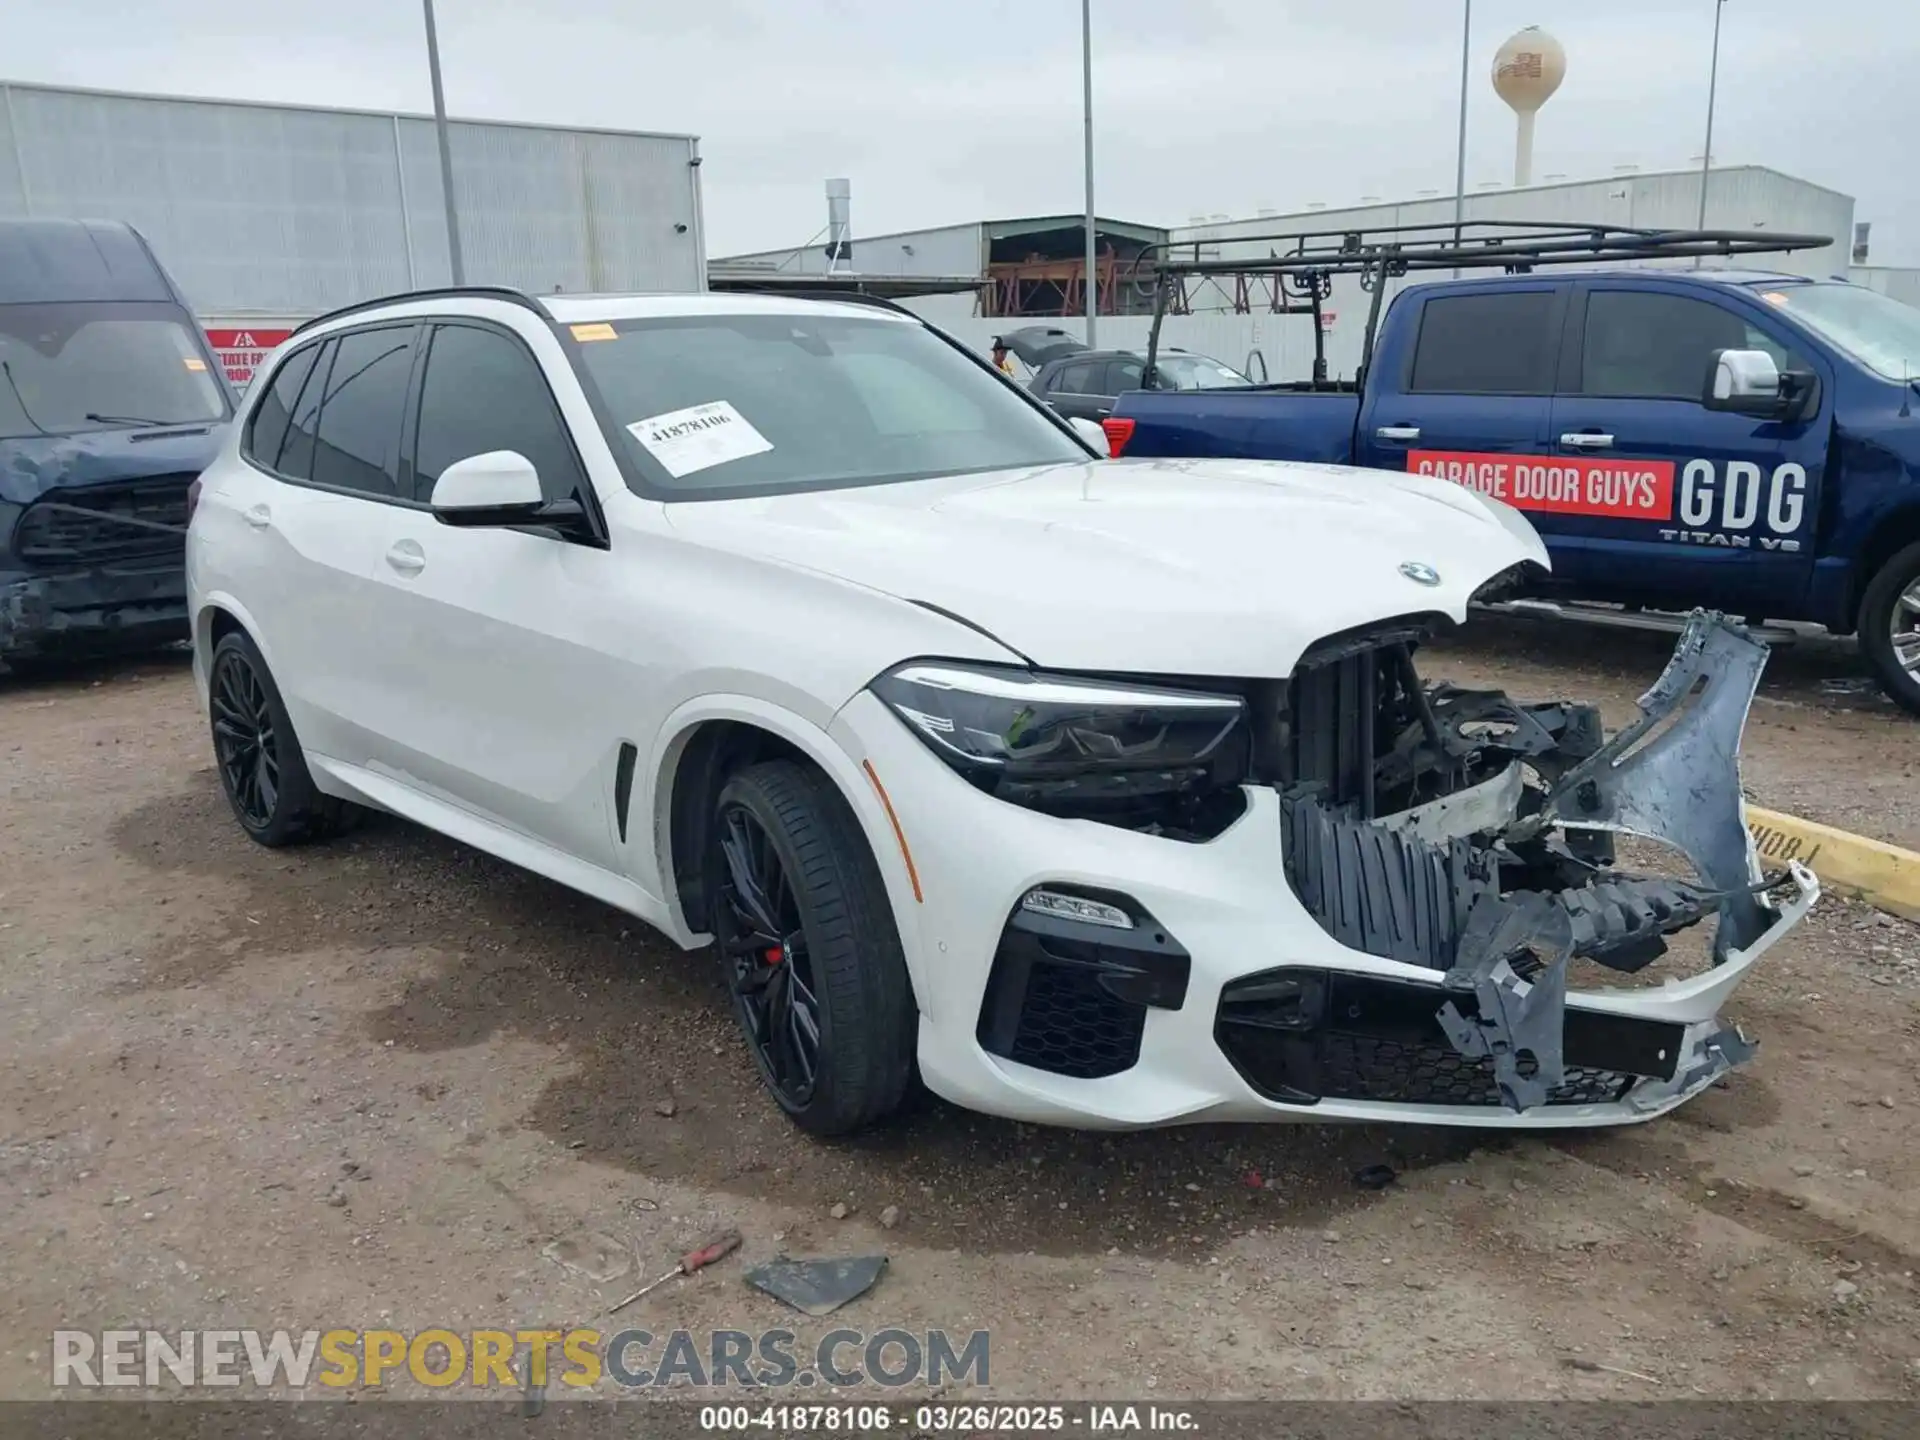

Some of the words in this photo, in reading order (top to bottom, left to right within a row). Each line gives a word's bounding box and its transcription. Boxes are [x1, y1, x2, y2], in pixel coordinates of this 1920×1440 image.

[220, 352, 249, 366] TATE
[1514, 464, 1580, 503] DOOR
[1587, 468, 1657, 509] GUYS
[1680, 458, 1807, 534] GDG
[1658, 528, 1751, 548] TITAN
